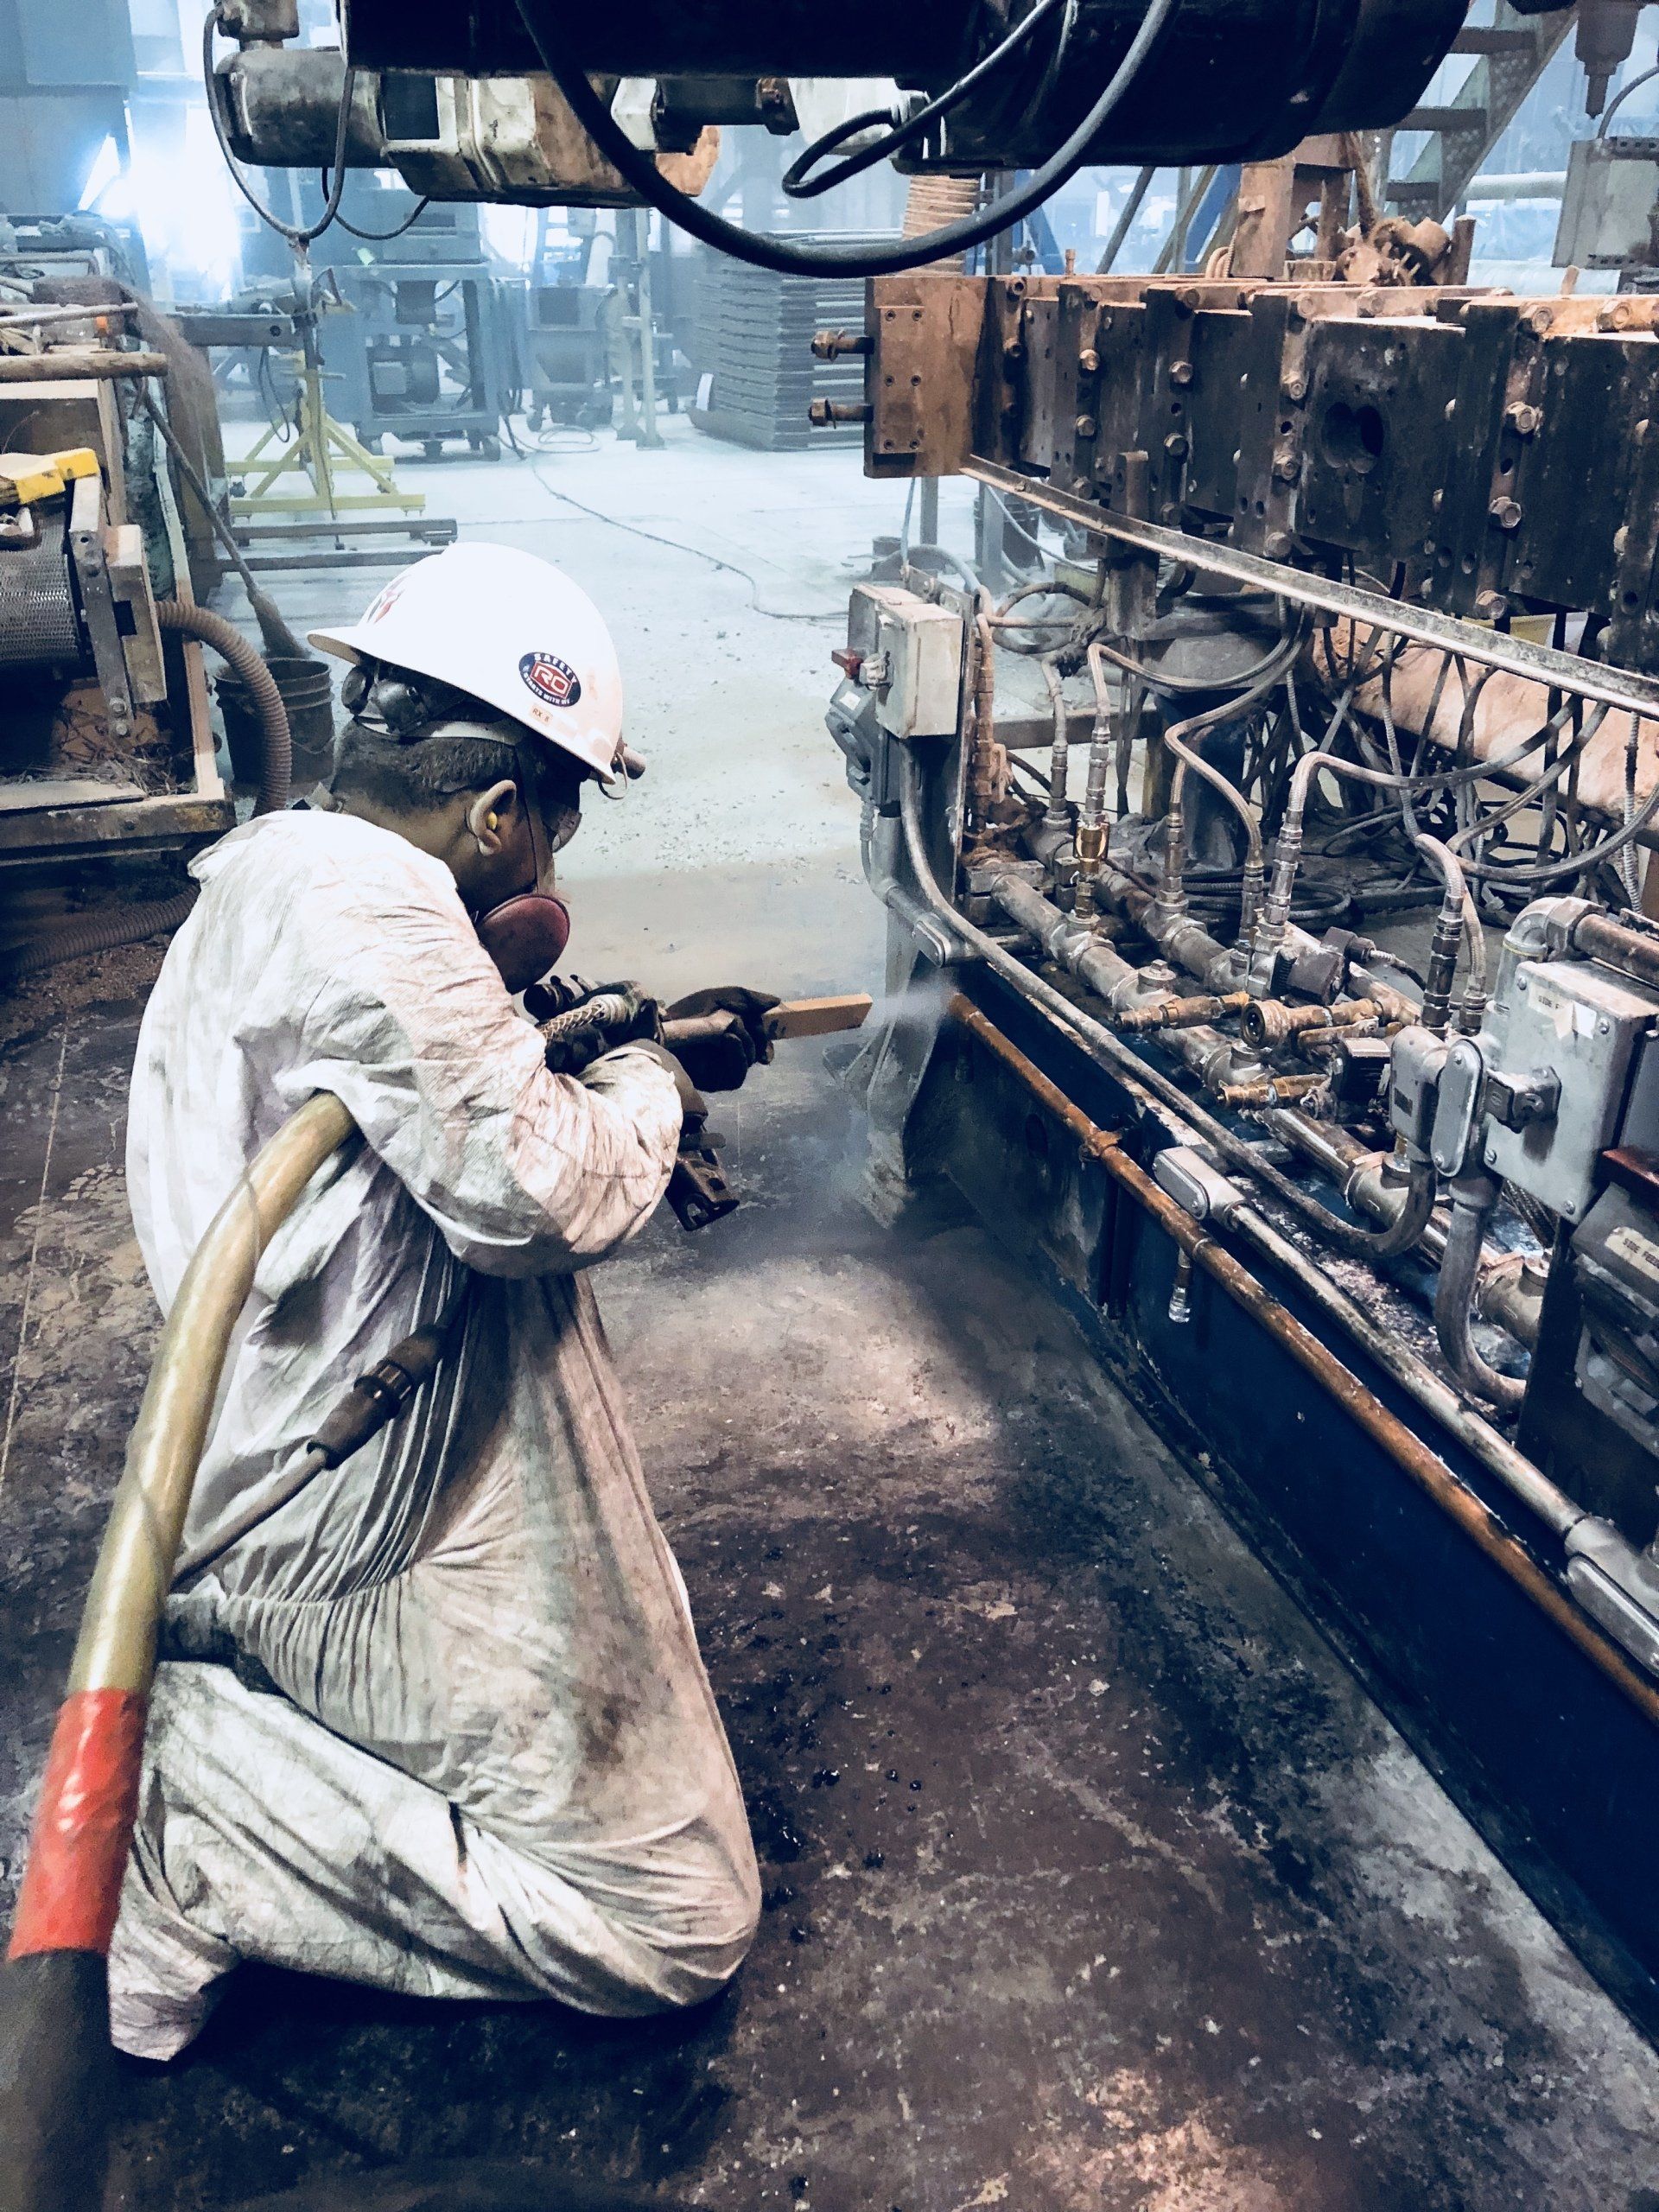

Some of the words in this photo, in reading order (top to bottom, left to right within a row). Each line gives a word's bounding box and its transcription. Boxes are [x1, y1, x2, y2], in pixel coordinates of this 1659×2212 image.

[534, 653, 577, 683] SAFETY
[524, 672, 543, 696] STARTS
[543, 694, 560, 704] WITH
[1538, 995, 1553, 1007] SIDE
[1623, 1237, 1641, 1254] SIDE
